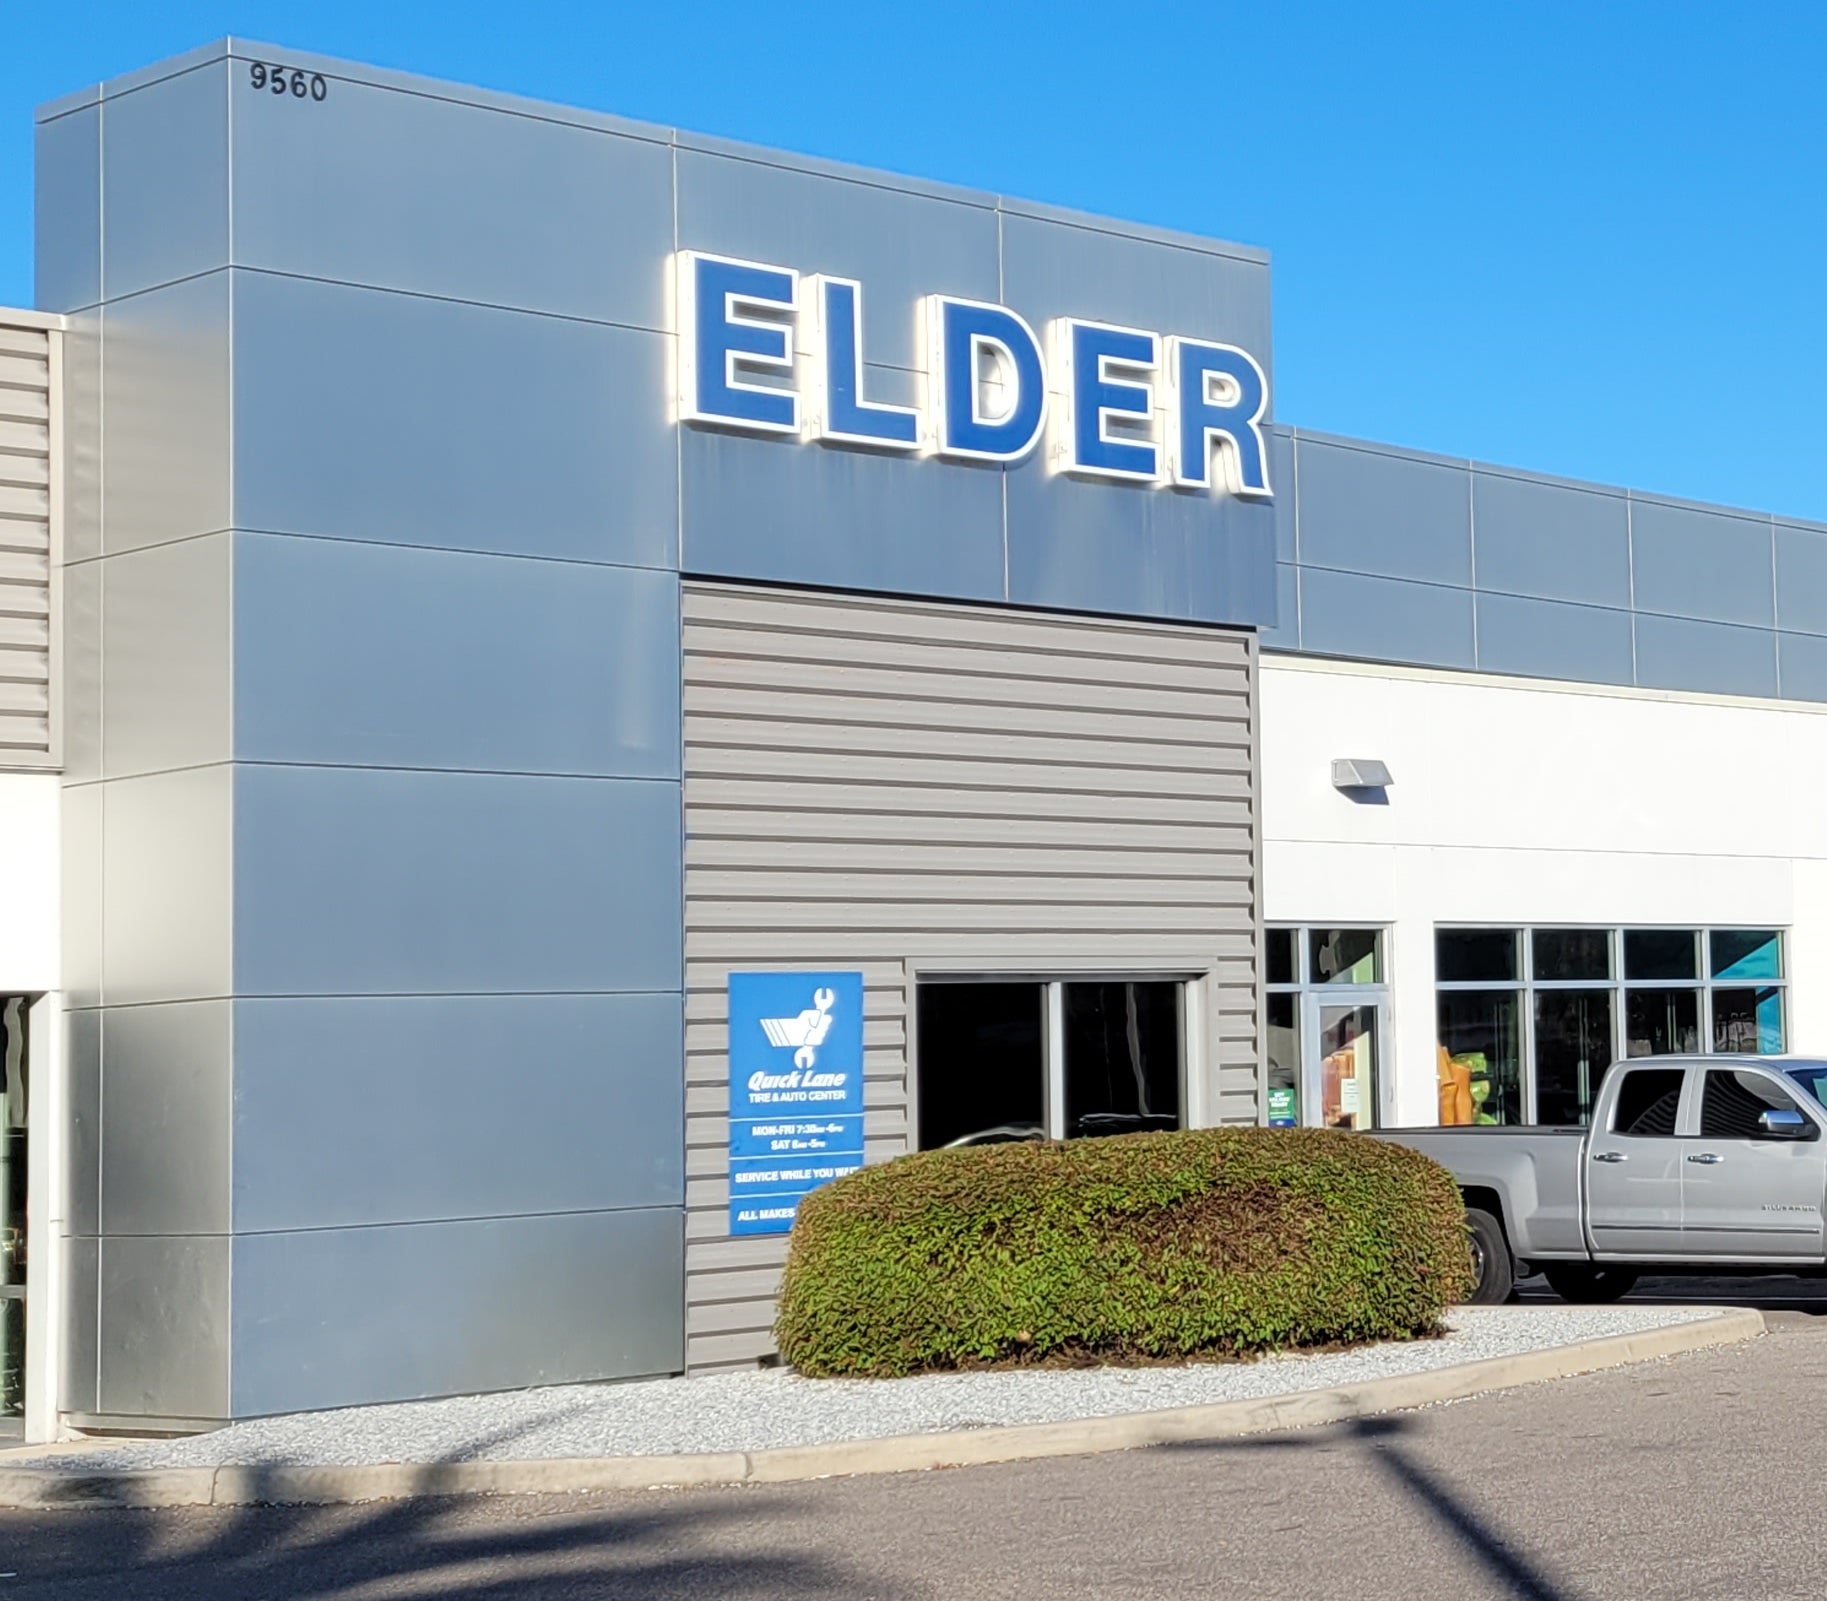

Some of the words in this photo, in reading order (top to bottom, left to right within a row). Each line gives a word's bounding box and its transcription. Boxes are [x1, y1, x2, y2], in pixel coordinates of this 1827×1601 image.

[249, 62, 327, 102] 9560
[677, 249, 1273, 497] ELDER
[748, 1070, 801, 1091] Quick
[802, 1070, 847, 1087] Lane
[748, 1092, 771, 1103] TIRE
[772, 1092, 779, 1102] &
[779, 1091, 807, 1102] AUTO
[808, 1090, 846, 1101] CENTER
[752, 1124, 796, 1136] MON-FRI
[770, 1140, 791, 1150] SAT
[735, 1170, 779, 1183] SERVICE
[780, 1169, 811, 1180] WHILE
[812, 1168, 834, 1178] YOU
[737, 1209, 758, 1221] ALL
[759, 1207, 796, 1219] MAKES
